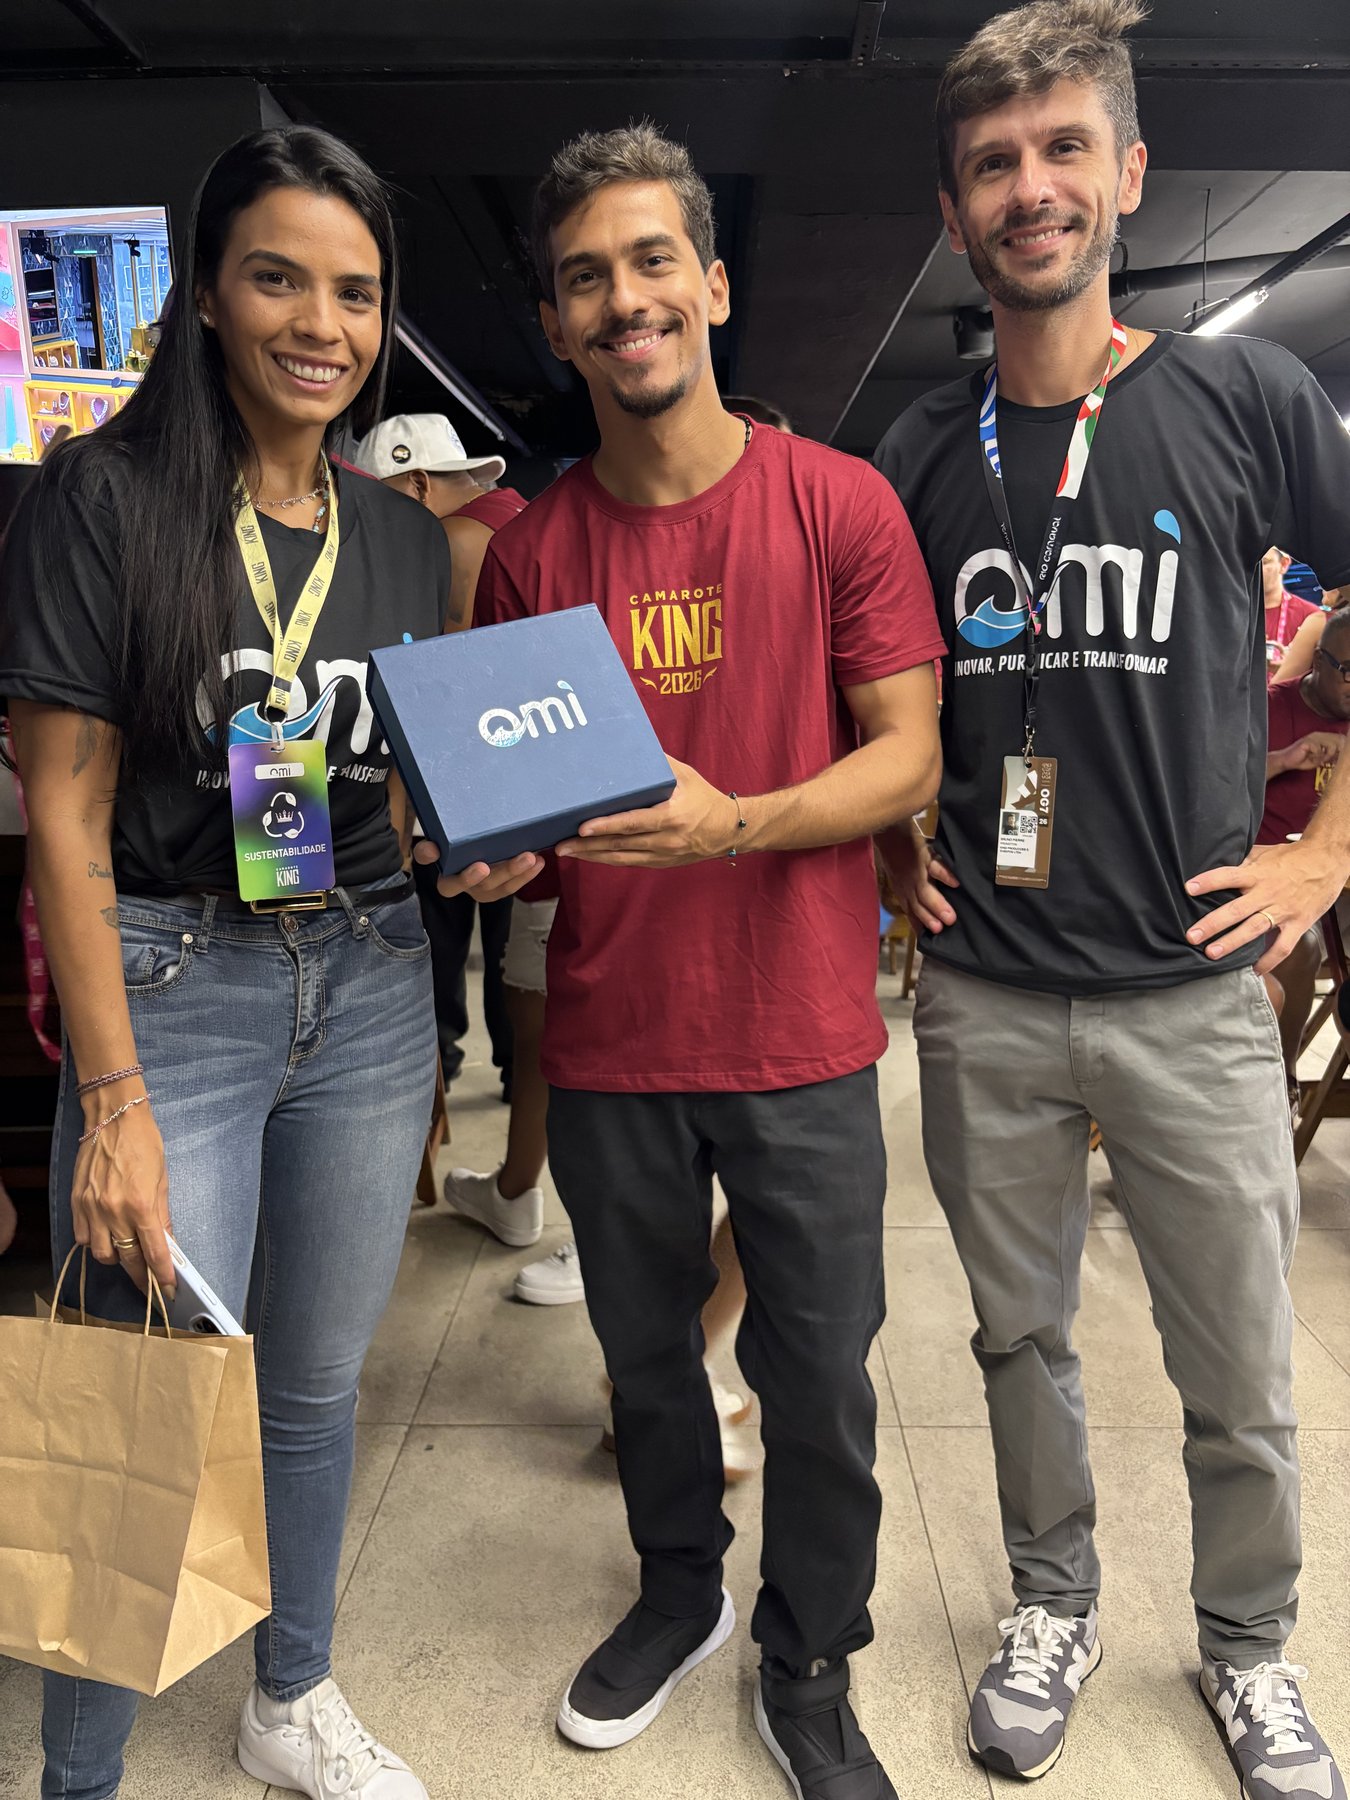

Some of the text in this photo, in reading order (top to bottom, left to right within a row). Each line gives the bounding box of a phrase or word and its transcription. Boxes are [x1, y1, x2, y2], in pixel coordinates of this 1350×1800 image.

[240, 524, 258, 545] KING
[251, 561, 269, 584] KING
[307, 574, 326, 598] KING
[629, 583, 722, 606] CAMAROTE
[294, 609, 313, 627] KING
[629, 598, 723, 670] KING
[283, 639, 303, 663] KING
[954, 650, 1169, 676] INOVAR, PURICAR E TRANSFORMAR
[660, 669, 702, 695] 2026
[478, 680, 588, 748] omi
[269, 764, 291, 777] omi
[244, 843, 327, 862] SUSTENTABILIDADE
[276, 868, 300, 888] KING
